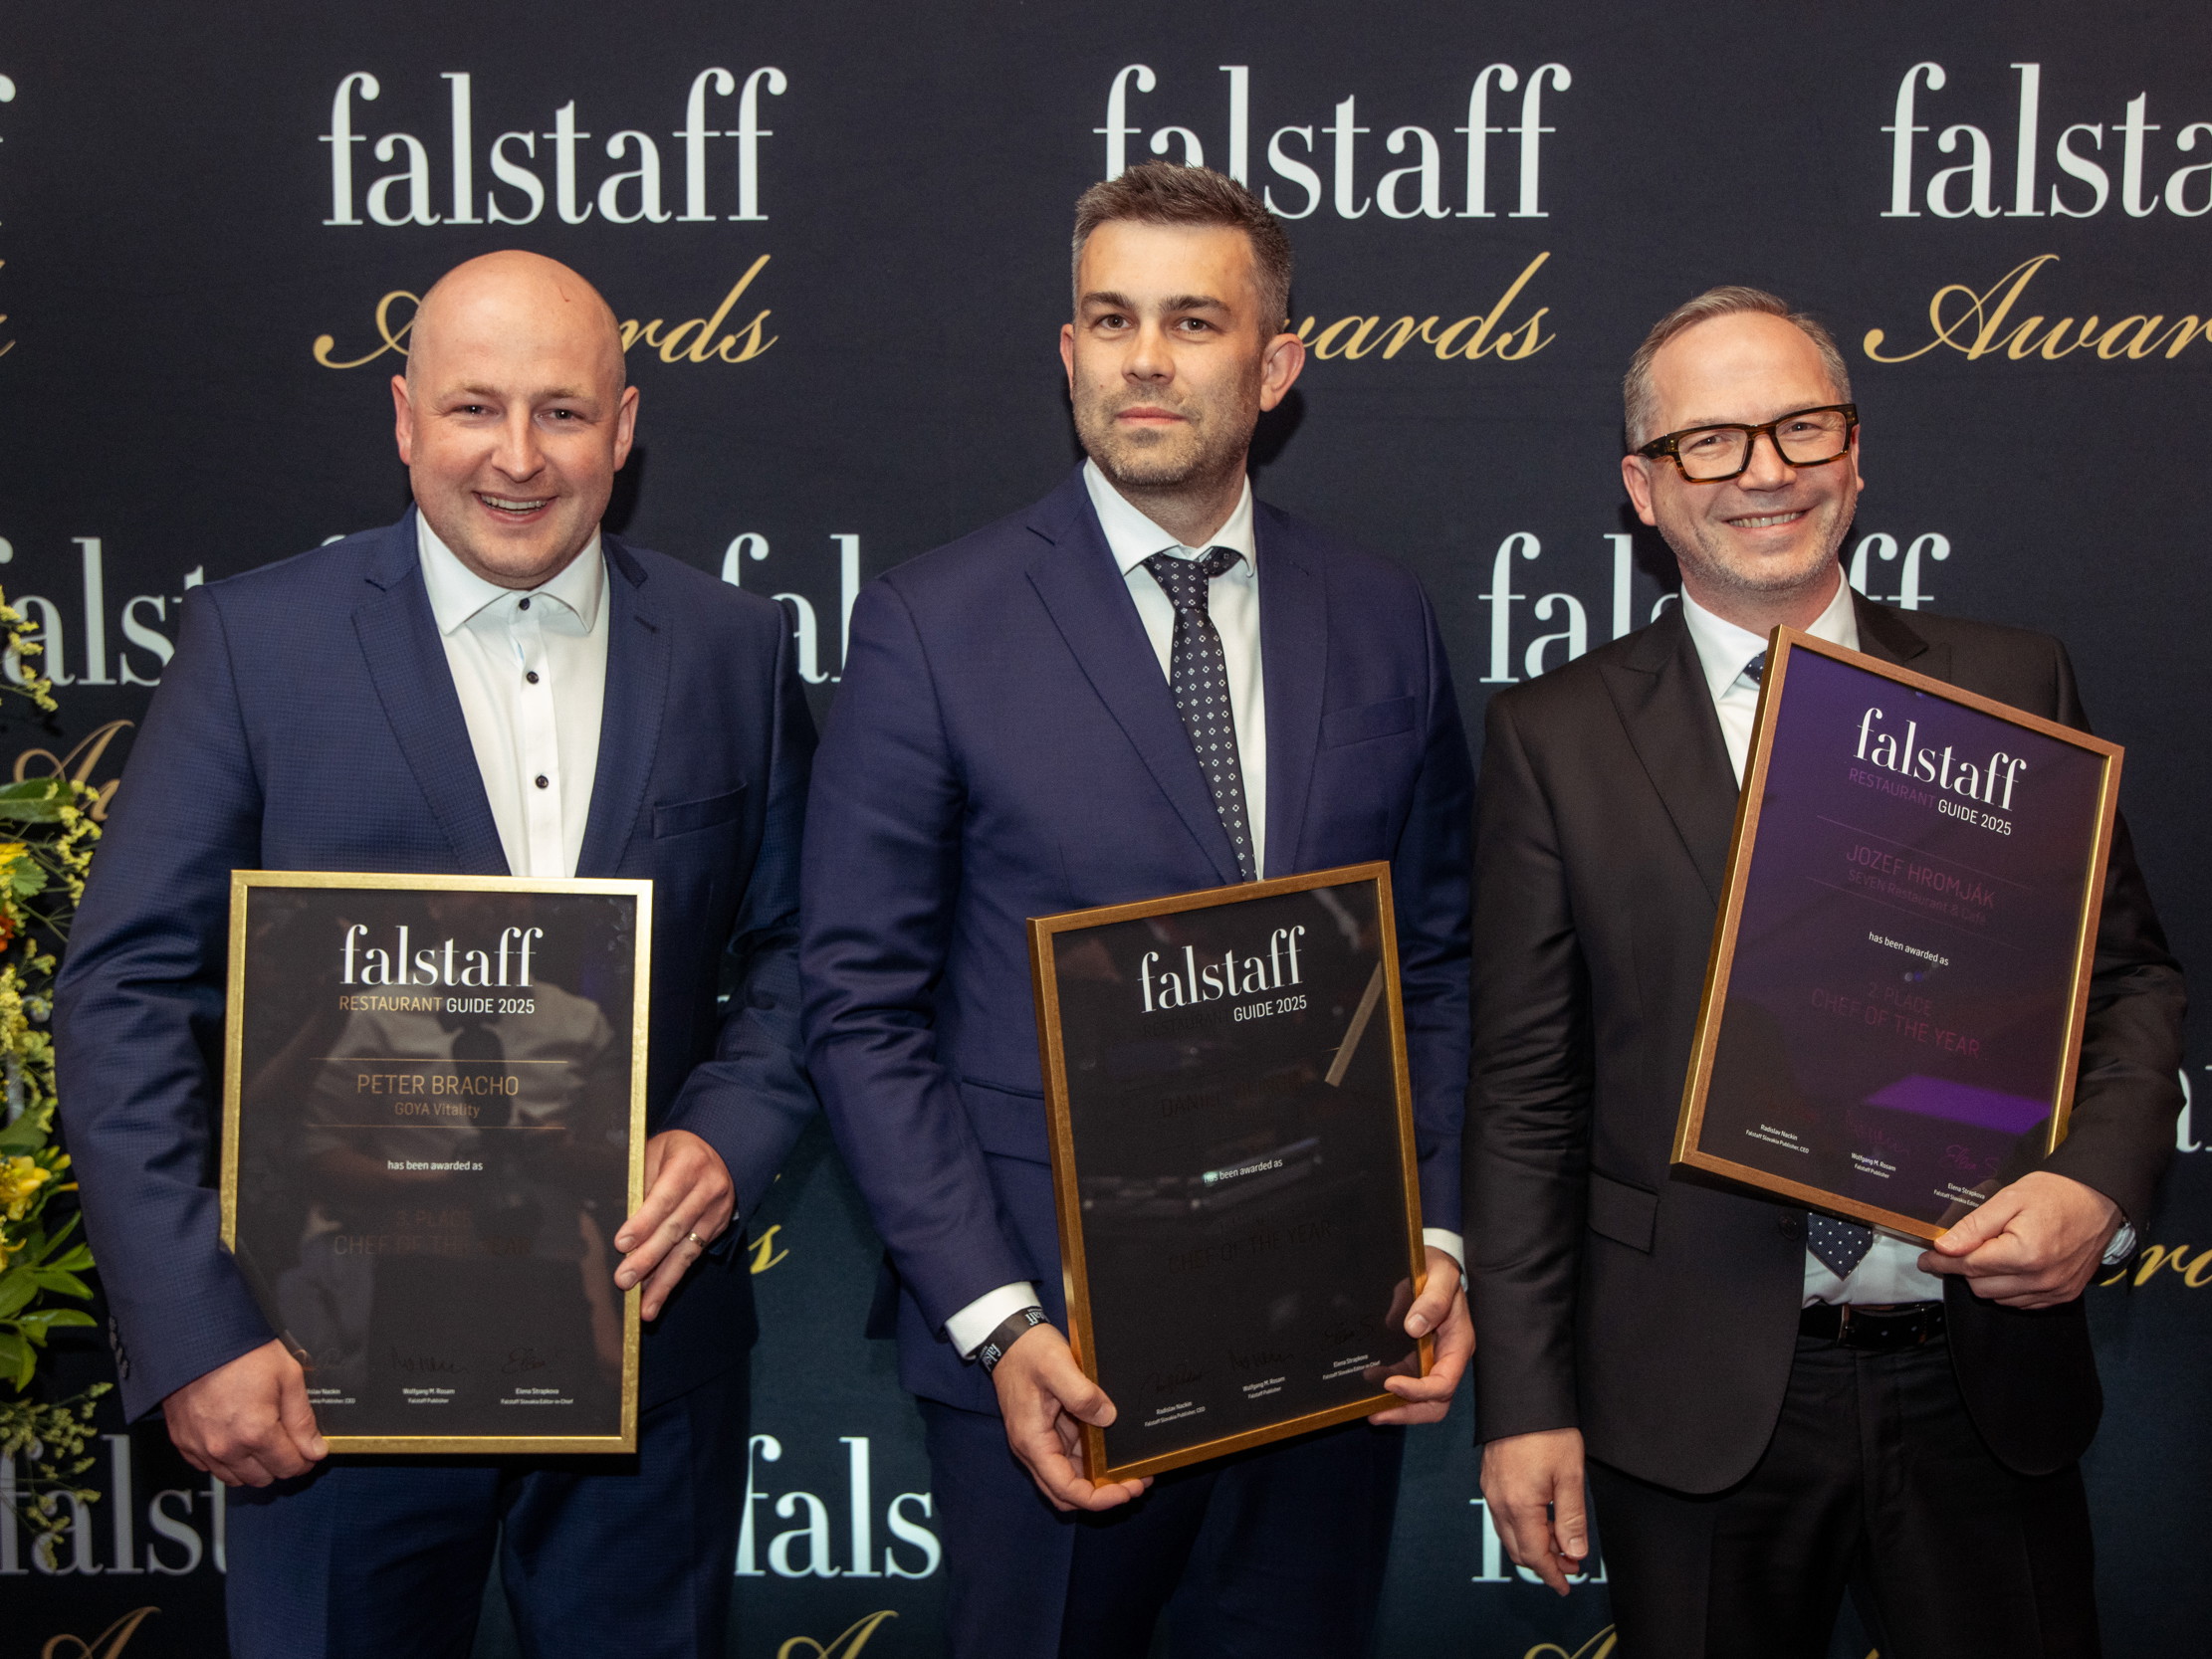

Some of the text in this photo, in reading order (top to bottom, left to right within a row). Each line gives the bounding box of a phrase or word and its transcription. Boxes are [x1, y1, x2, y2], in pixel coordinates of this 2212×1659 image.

[319, 67, 787, 226] falstaff
[1880, 62, 2212, 218] falsta
[1284, 252, 1556, 360] ards
[1864, 254, 2212, 362] Awar
[1853, 708, 2027, 811] falstaff
[1849, 767, 2012, 836] RESTAURANT GUIDE 2025
[1847, 845, 1904, 876] JOZEF
[339, 924, 544, 987] falstaff
[1137, 925, 1305, 1013] falstaff
[1869, 932, 1949, 965] has been awarded as
[338, 995, 536, 1014] RESTAURANT GUIDE 2025
[1233, 1001, 1273, 1022] GUIDE
[1276, 994, 1307, 1014] 2025
[1811, 987, 1980, 1059] CHEF OF THE YEAR
[1884, 986, 1932, 1016] PLACE
[356, 1074, 520, 1096] PETER BRACHO
[394, 1102, 481, 1119] GOYA Vitality
[387, 1160, 484, 1171] has been awarded as
[1219, 1170, 1238, 1180] been
[1239, 1159, 1272, 1175] awarded
[1273, 1158, 1283, 1167] as
[333, 1235, 389, 1256] CHEF
[734, 1434, 942, 1579] fals
